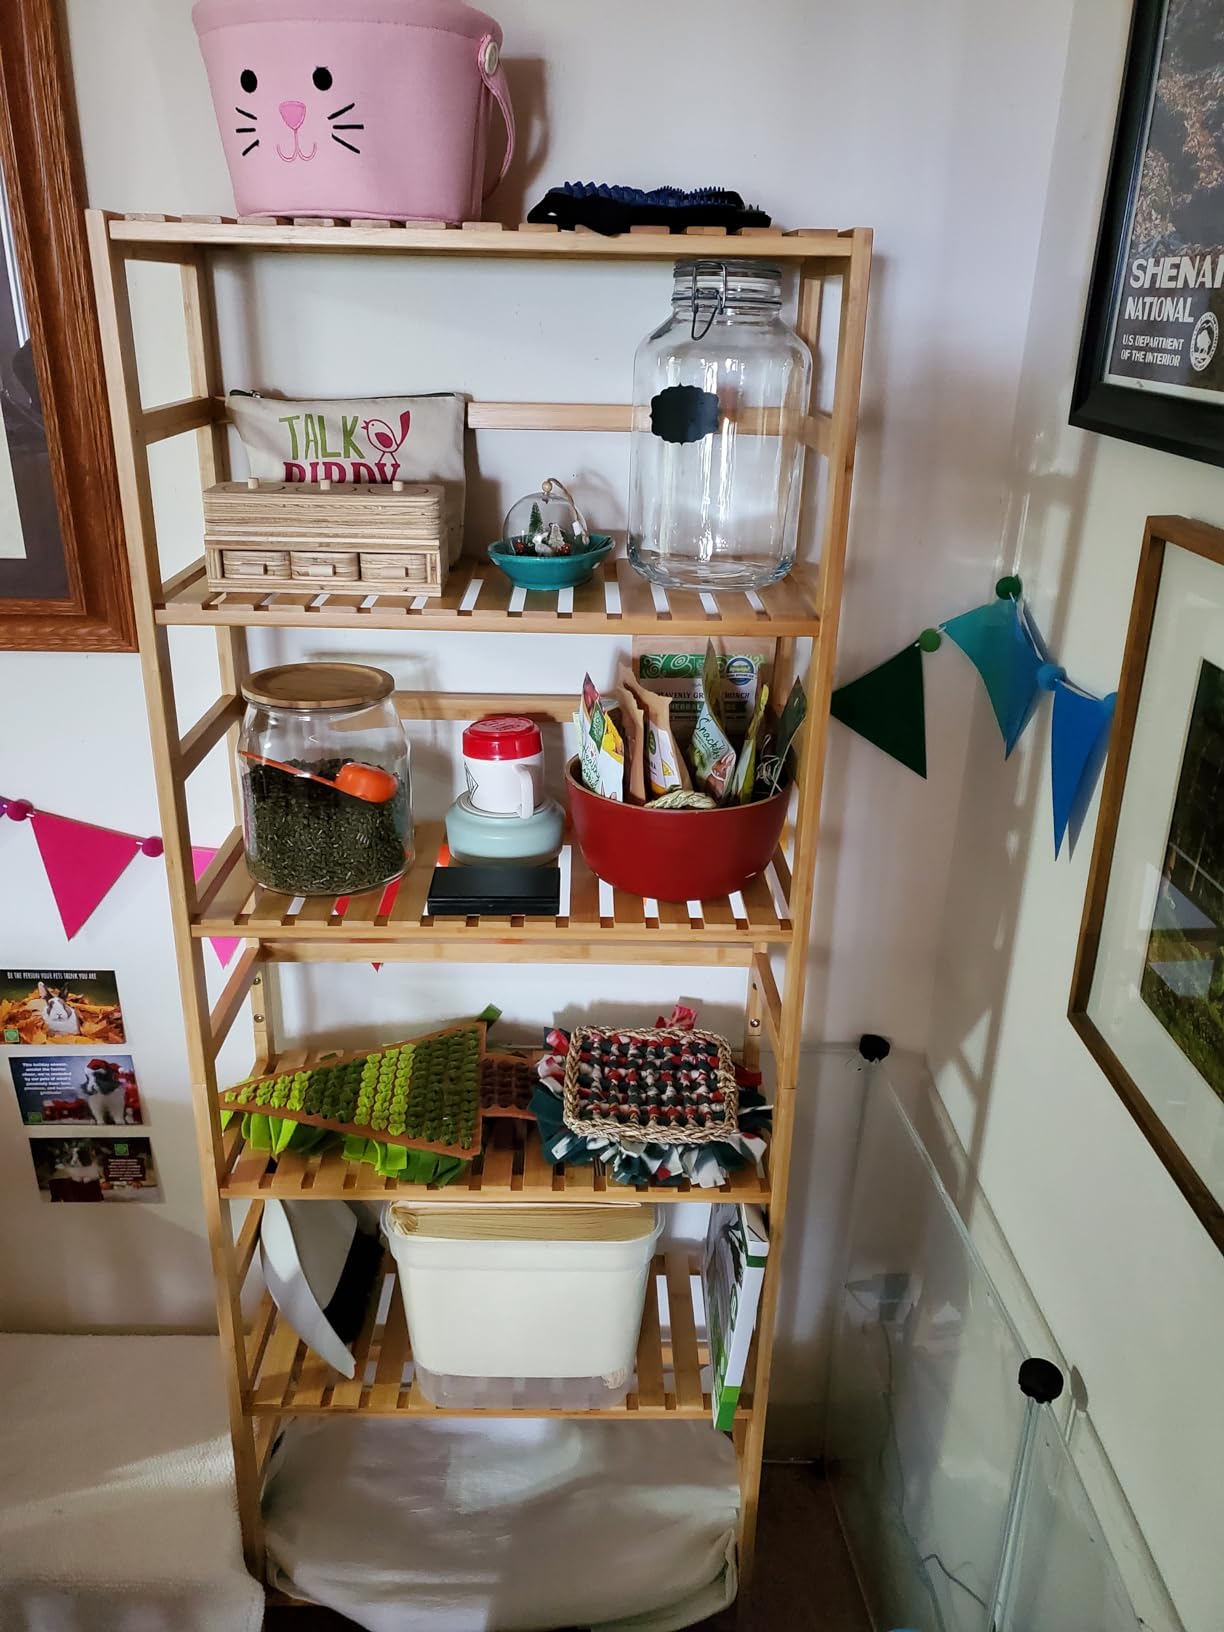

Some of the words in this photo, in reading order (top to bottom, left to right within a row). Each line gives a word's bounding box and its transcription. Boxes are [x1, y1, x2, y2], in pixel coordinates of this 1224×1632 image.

[1124, 296, 1194, 322] NATIONAL
[1135, 335, 1184, 351] DEPARTMENT
[1120, 349, 1131, 361] OF
[1131, 350, 1145, 363] THE
[1145, 353, 1181, 367] INTERIOR
[279, 414, 366, 460] TALK
